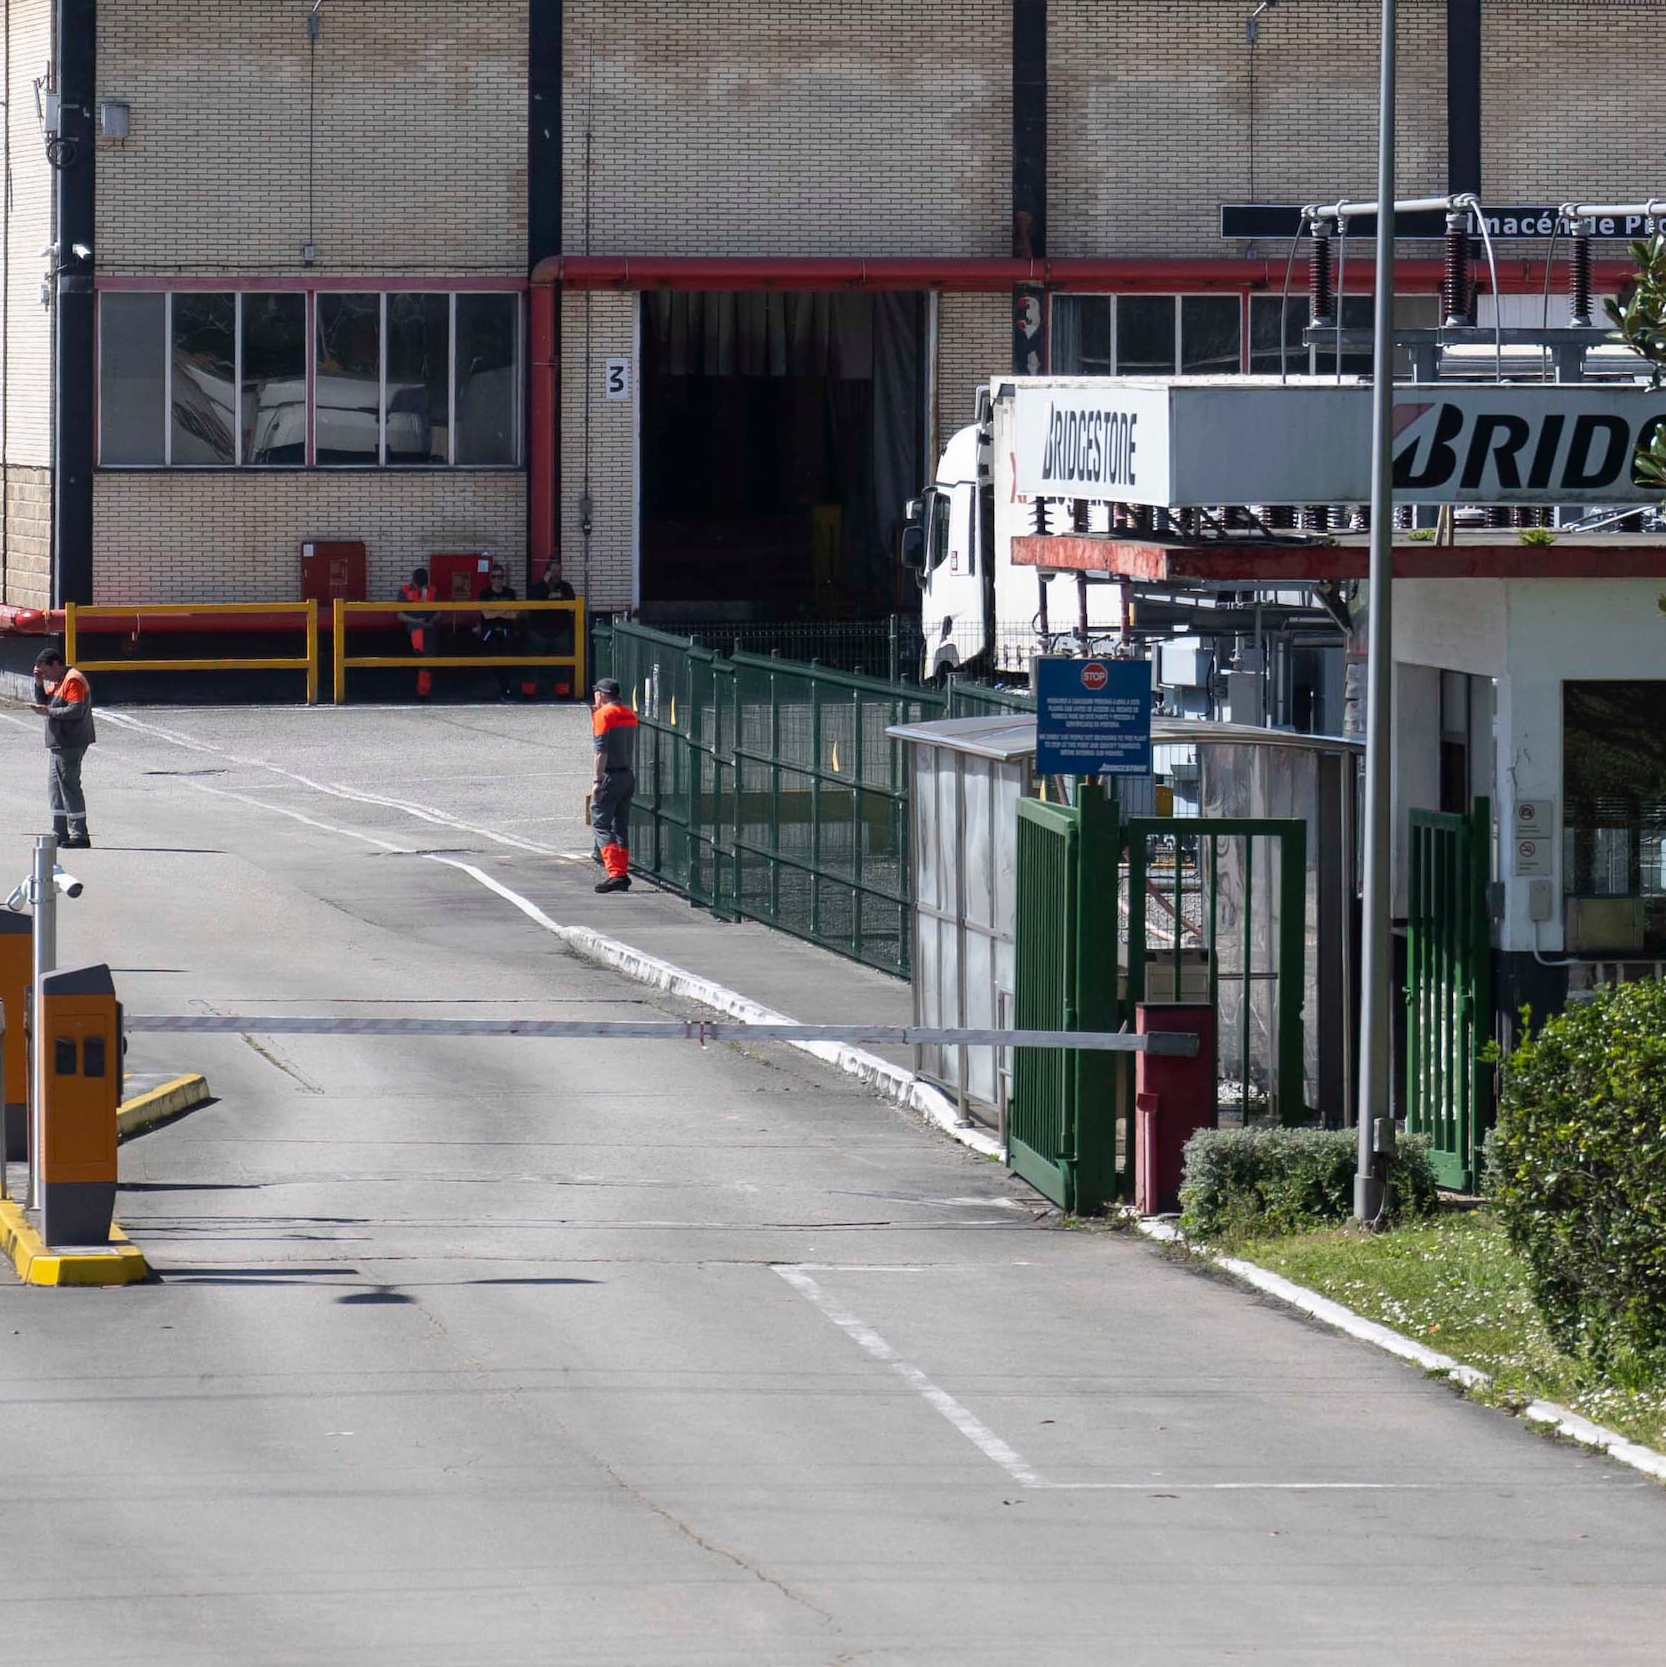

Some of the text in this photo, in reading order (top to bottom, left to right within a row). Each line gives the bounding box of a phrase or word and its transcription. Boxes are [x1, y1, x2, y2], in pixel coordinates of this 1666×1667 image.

[1464, 211, 1569, 234] lmacén
[610, 366, 624, 392] 3
[1041, 401, 1137, 486] BRIDGESTONE
[1083, 672, 1105, 681] STOP
